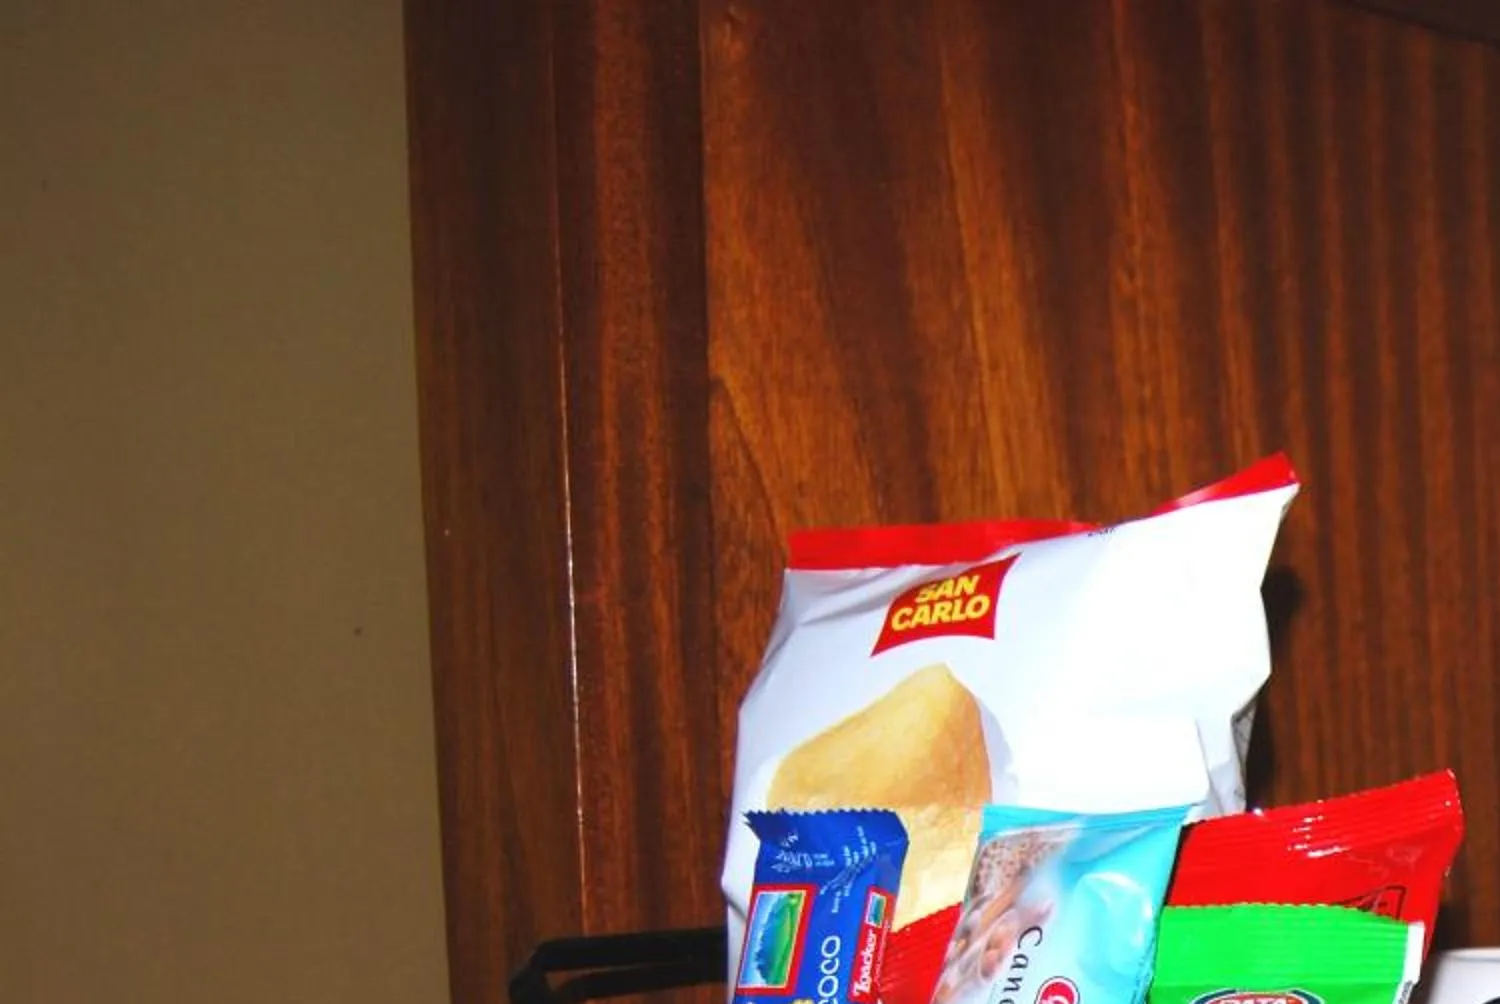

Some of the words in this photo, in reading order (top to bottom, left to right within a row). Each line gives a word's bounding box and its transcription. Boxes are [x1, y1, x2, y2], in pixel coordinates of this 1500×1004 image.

[915, 575, 981, 602] SAN
[890, 595, 990, 630] CARLO
[853, 929, 878, 996] Loacker
